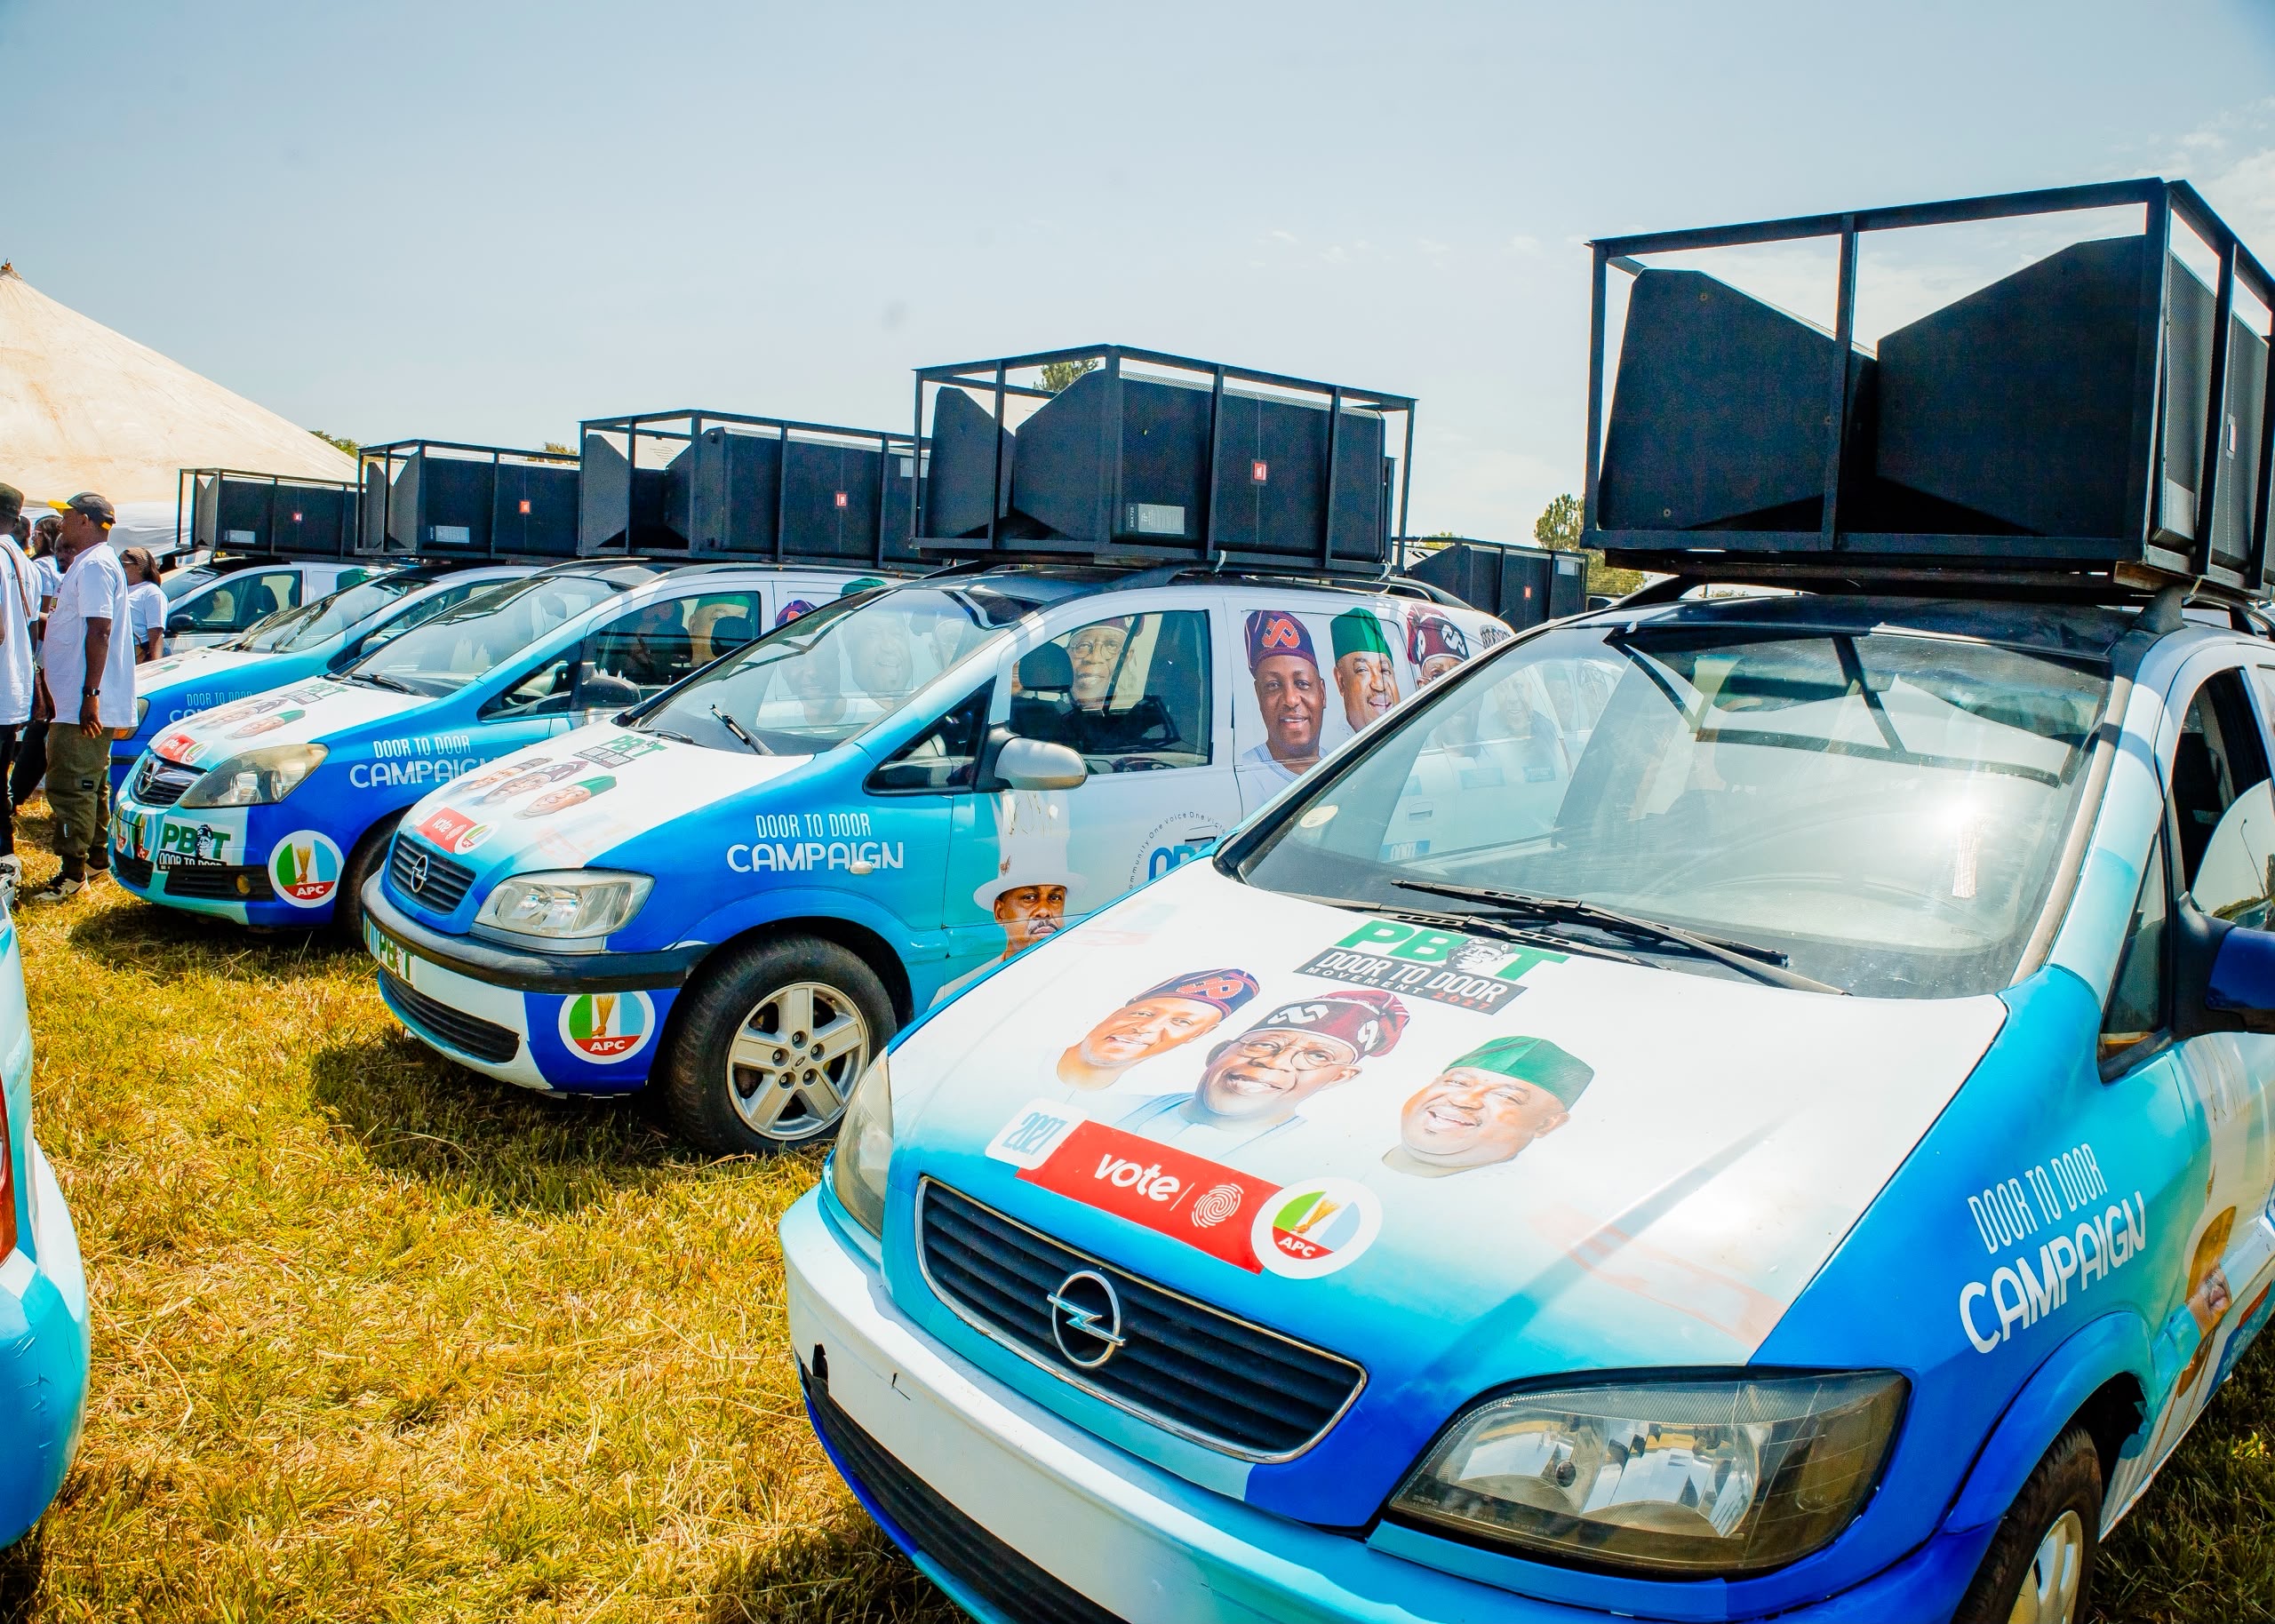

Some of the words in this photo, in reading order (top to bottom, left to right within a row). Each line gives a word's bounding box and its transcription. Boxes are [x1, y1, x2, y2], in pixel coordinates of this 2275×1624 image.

[187, 693, 212, 707] DOOR
[373, 739, 411, 759] DOOR
[413, 736, 431, 756] TO
[434, 735, 471, 754] DOOR
[755, 814, 801, 839] DOOR
[804, 813, 824, 837] TO
[828, 813, 872, 837] DOOR
[726, 841, 904, 873] CAMPAIGN
[1128, 839, 1150, 889] ommunity
[1148, 823, 1163, 839] One
[1164, 811, 1187, 824] Voice
[1189, 811, 1205, 820] One
[296, 885, 324, 896] APC
[1305, 966, 1425, 994] MOVEMENT
[1431, 991, 1491, 1010] 2027
[1317, 951, 1387, 977] DOOR
[1388, 963, 1432, 985] TO
[1430, 972, 1508, 1003] DOOR
[589, 1039, 626, 1053] APC
[1002, 1111, 1068, 1156] 2027
[1094, 1153, 1181, 1202] vote
[1968, 1195, 2039, 1254] DOOR
[2024, 1165, 2062, 1225] TO
[2050, 1142, 2108, 1213] DOOR
[1278, 1236, 1316, 1258] APC
[1959, 1190, 2146, 1354] CAMPAIGN
